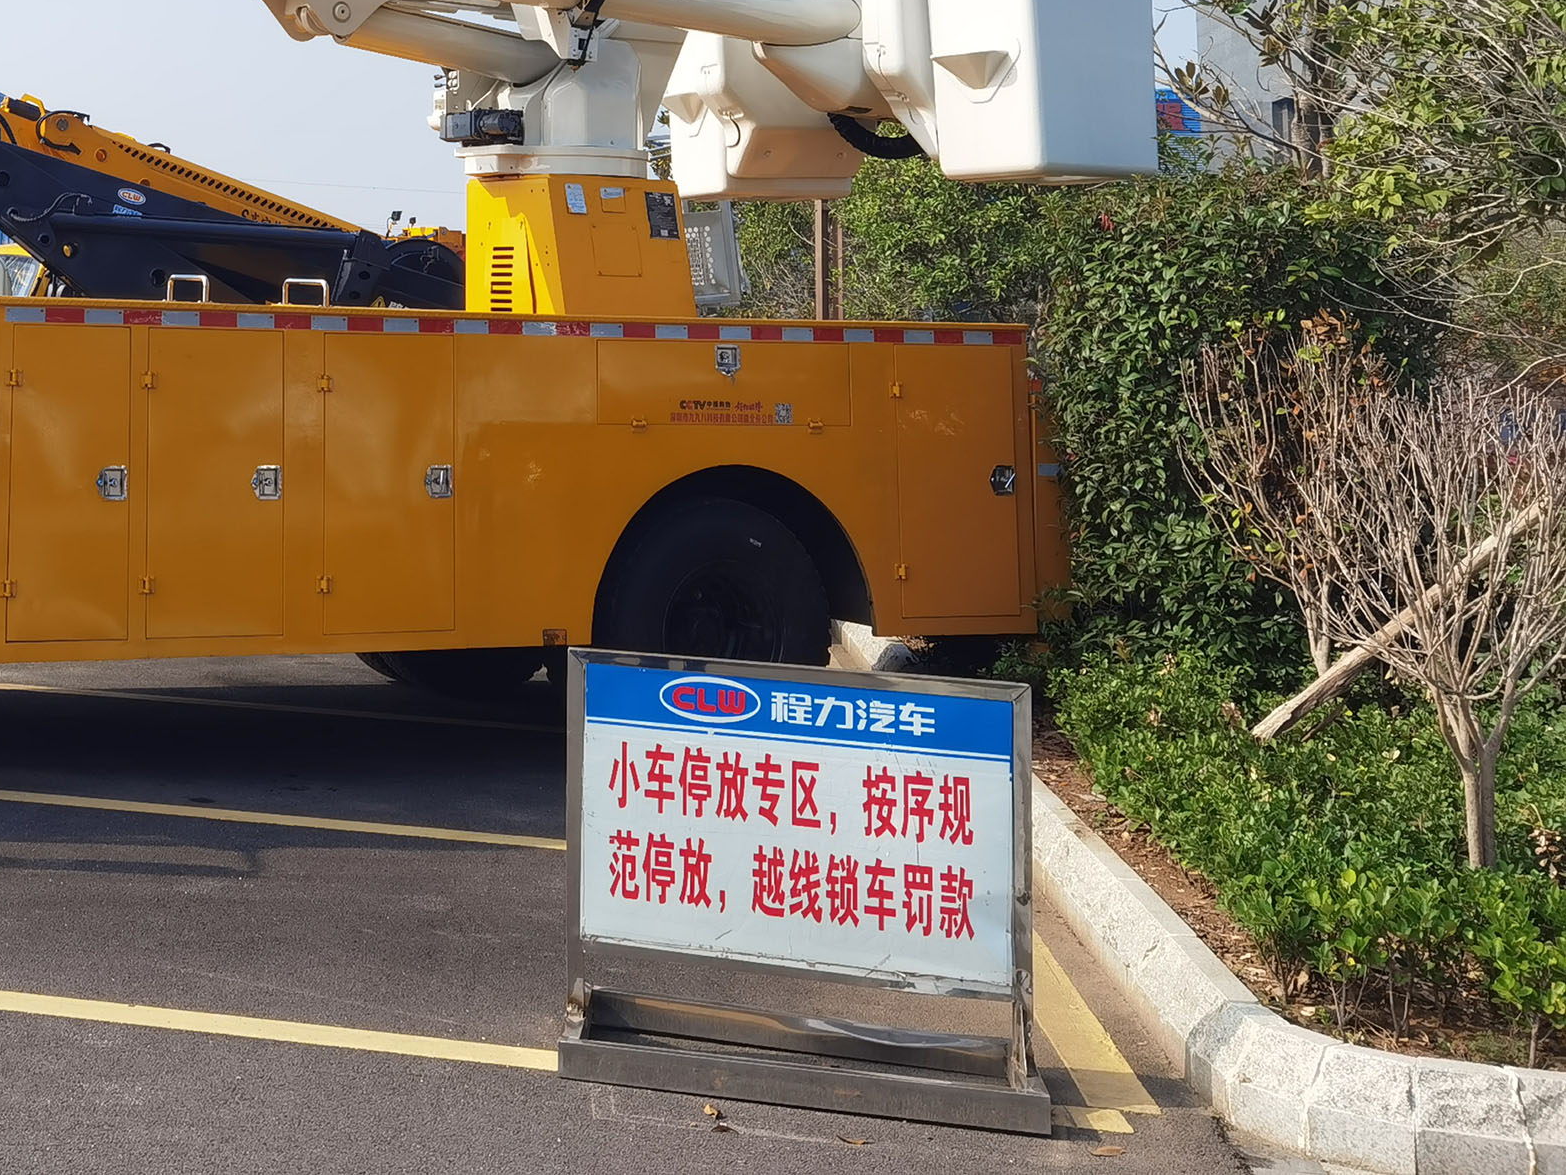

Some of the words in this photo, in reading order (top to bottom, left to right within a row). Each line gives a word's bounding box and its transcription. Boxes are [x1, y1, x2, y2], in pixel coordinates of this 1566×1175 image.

[672, 686, 746, 714] CLW
[770, 691, 936, 736] 程力汽车
